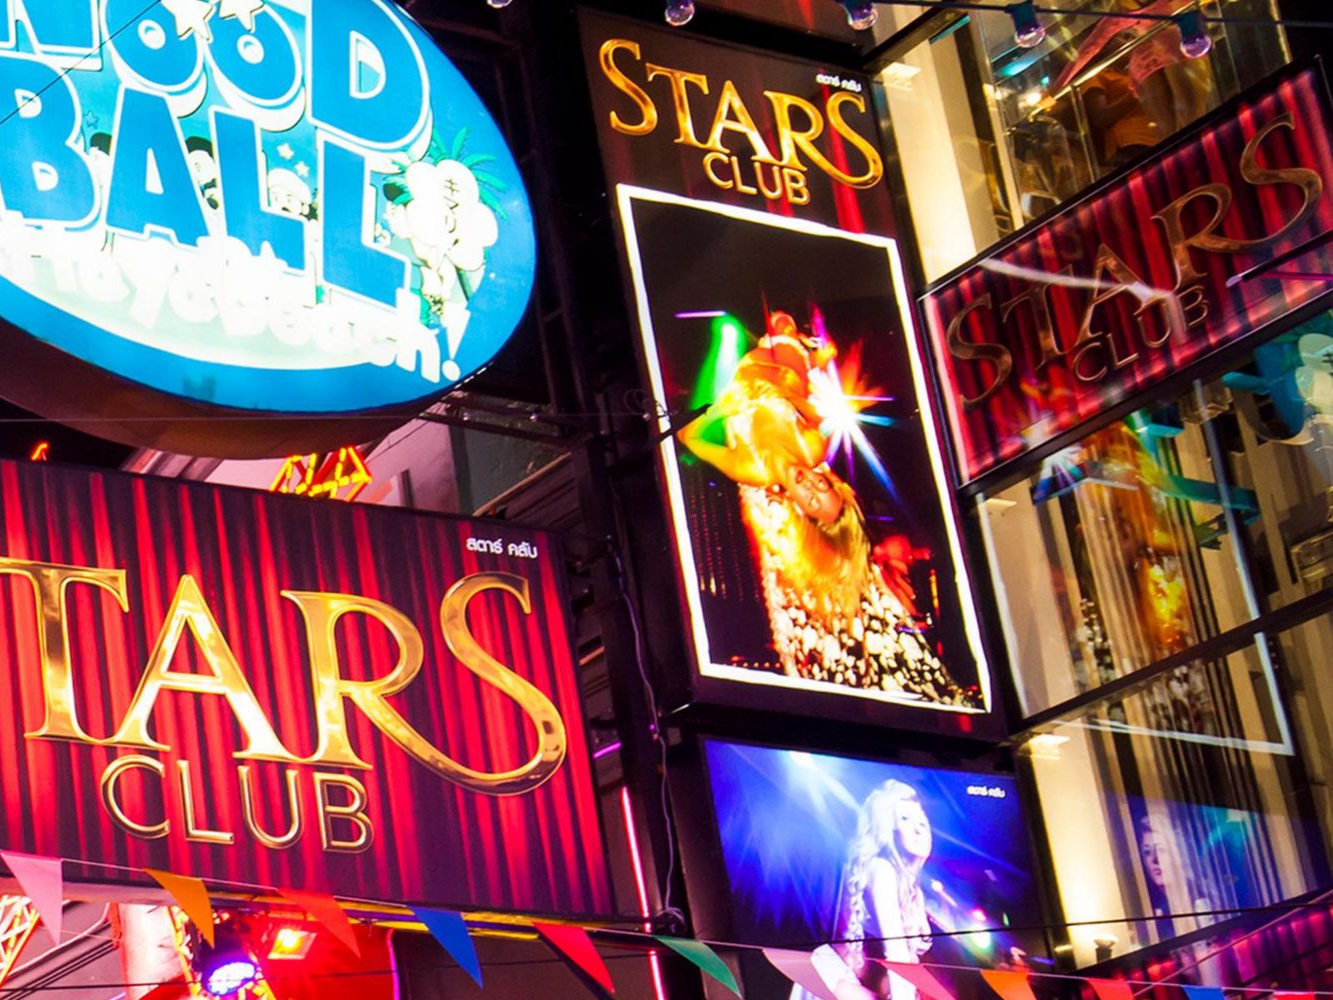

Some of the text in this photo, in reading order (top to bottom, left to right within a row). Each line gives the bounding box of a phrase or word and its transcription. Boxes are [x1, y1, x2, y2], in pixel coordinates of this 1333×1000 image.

[598, 38, 883, 190] STARS
[703, 152, 811, 206] CLUB
[944, 112, 1325, 404] STARS
[1072, 284, 1211, 384] CLUB
[98, 753, 376, 855] CLUB
